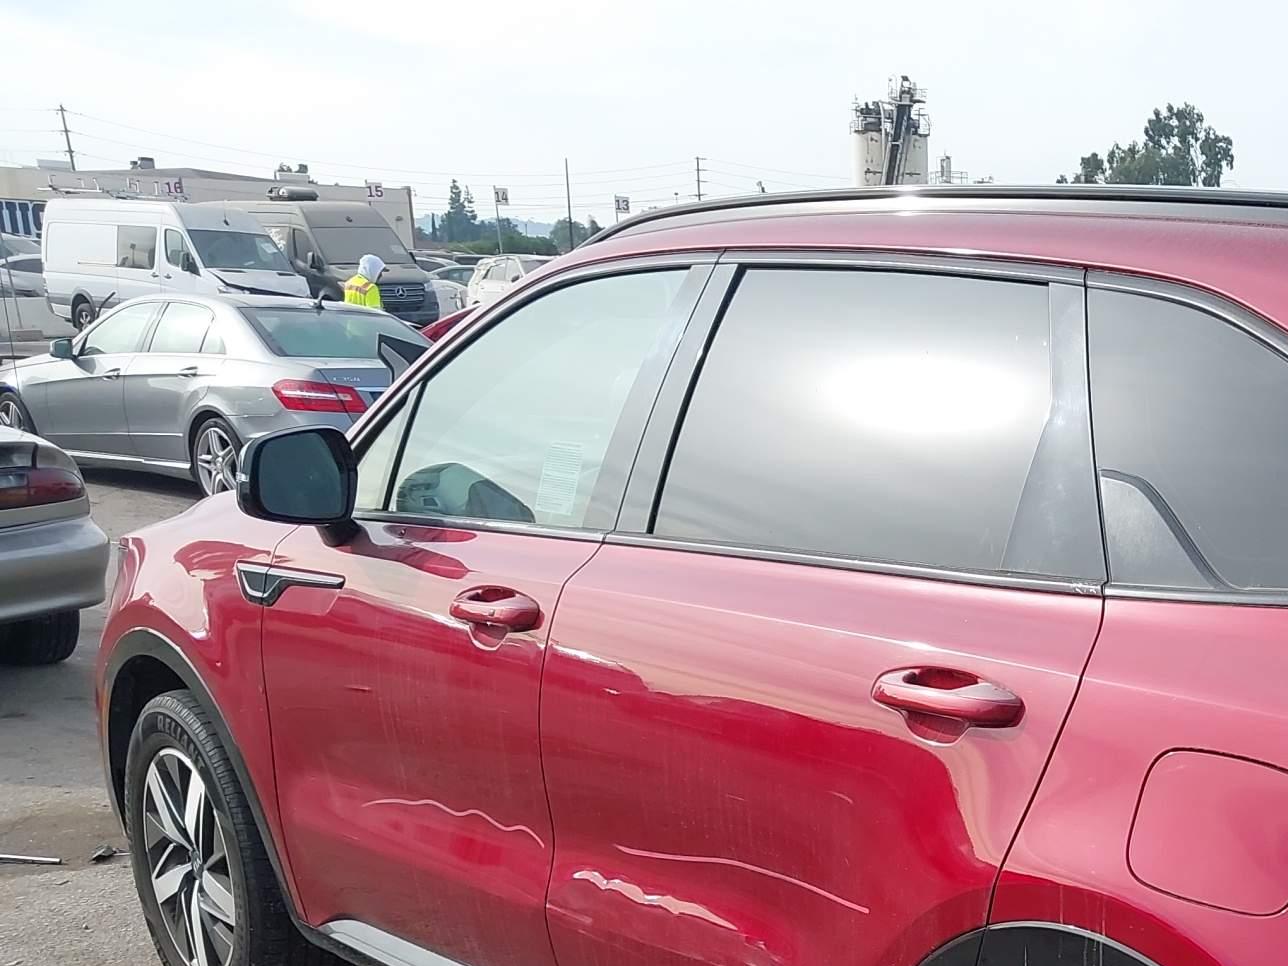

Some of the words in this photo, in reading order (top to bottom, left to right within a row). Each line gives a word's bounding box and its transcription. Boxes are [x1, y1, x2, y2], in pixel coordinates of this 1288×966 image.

[367, 185, 384, 198] 15
[494, 191, 509, 203] 14
[615, 199, 630, 211] 13
